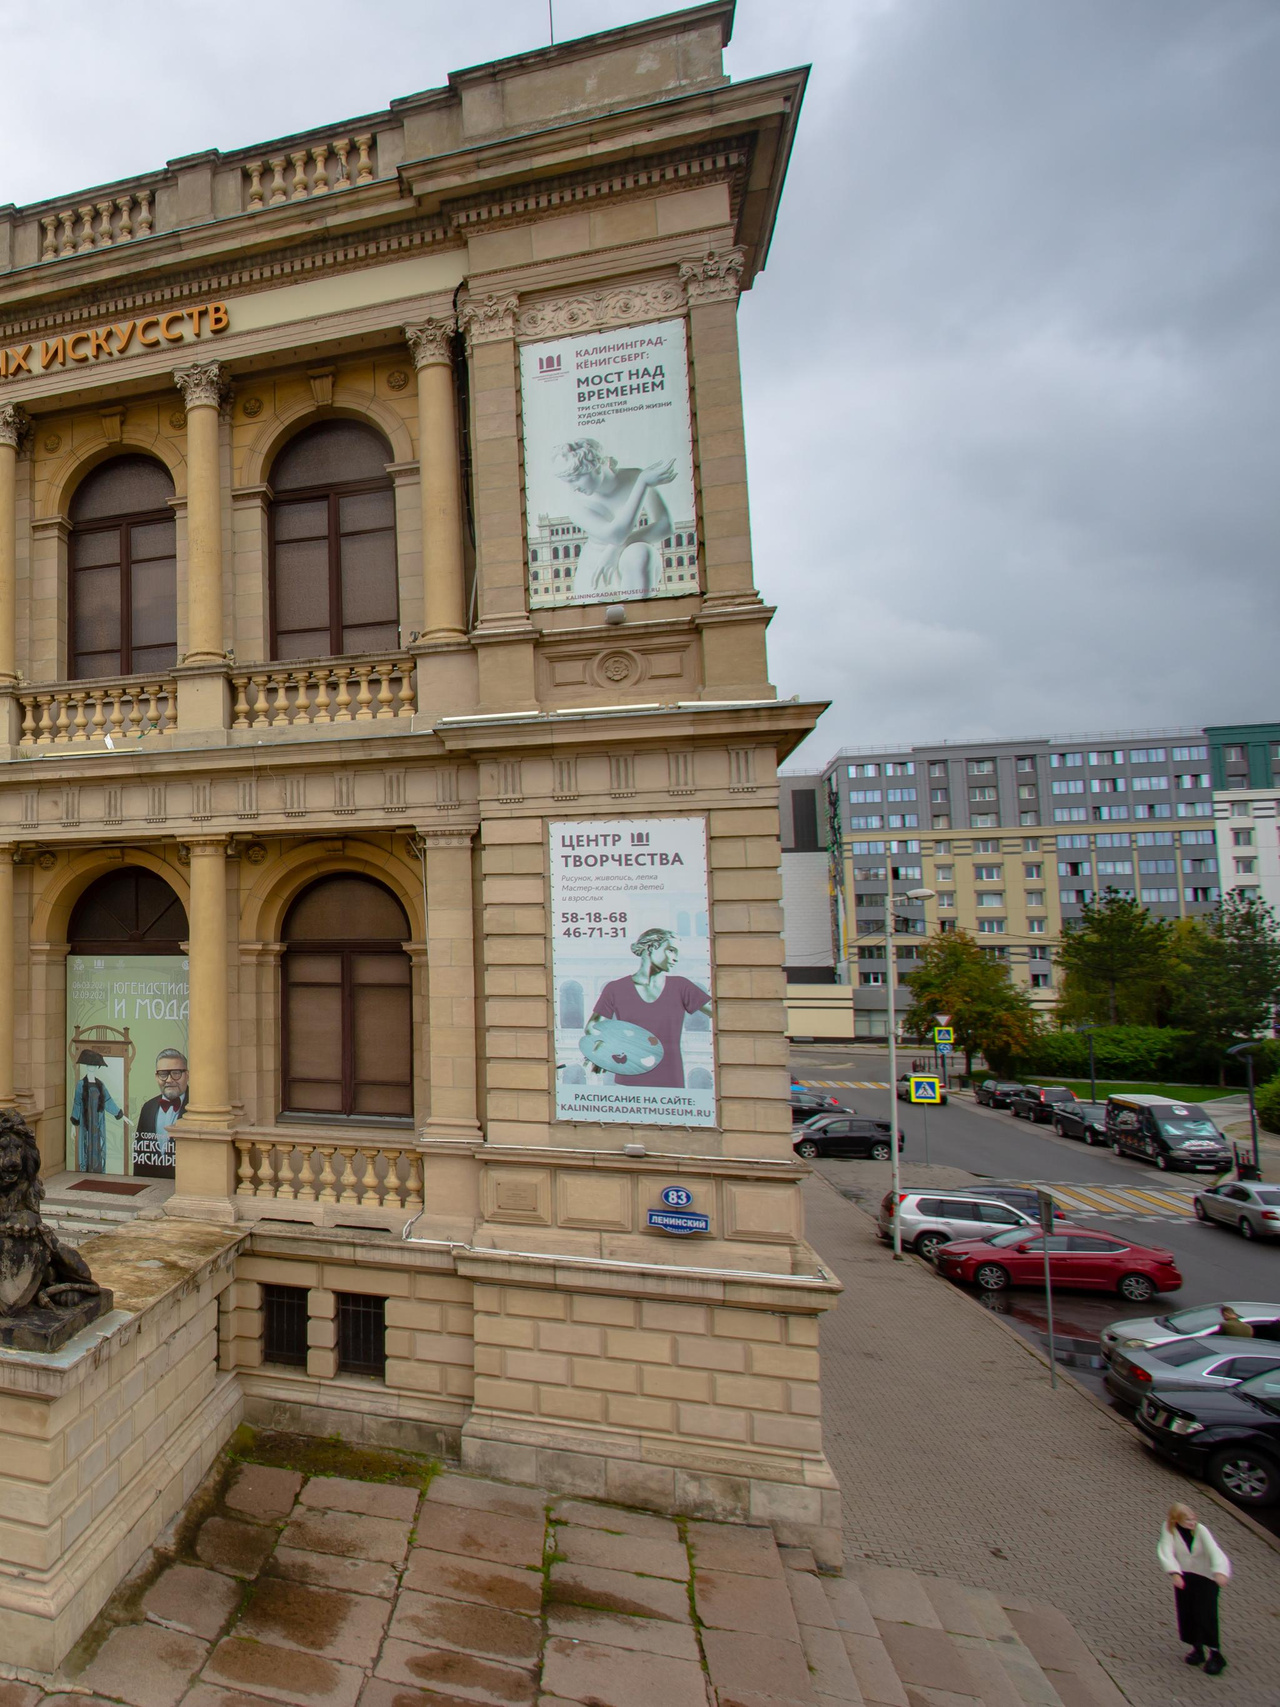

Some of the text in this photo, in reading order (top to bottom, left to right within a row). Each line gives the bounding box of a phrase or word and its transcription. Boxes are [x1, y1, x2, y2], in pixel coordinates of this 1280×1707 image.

[40, 302, 230, 370] ИСКУССТВ
[575, 336, 667, 358] КАЛИНИНГРАД-
[576, 351, 649, 370] КЁНИГСБЕРГ:
[577, 371, 624, 388] МОСТ
[628, 365, 665, 380] НАД
[577, 380, 665, 403] ВРЕМЕНЕМ
[577, 400, 628, 412] ТРИ СТОЛЕТИЯ
[577, 401, 672, 419] ХУДОЖЕСТВЕННОЙ ЖИЗНИ
[577, 418, 606, 427] ГОРОДА
[561, 833, 622, 851] ЦЕНТР
[561, 852, 684, 868] ТВОРЧЕСТВА
[561, 875, 593, 883] Рисунок,
[561, 883, 665, 893] Мастер-классы для детей
[567, 895, 604, 903] взрослых
[561, 912, 628, 923] 58-18-68
[562, 927, 627, 938] 46-71-31
[114, 999, 189, 1020] И МОДА
[574, 1093, 696, 1106] РАСПИСАНИЕ НА САЙТЕ:
[560, 1103, 711, 1117] KALININGRADARTMUSEUM.RU
[132, 1140, 176, 1153] АЛЕКСАН
[668, 1191, 687, 1204] 83
[651, 1215, 706, 1229] ЛЕНИНСКИЙ
